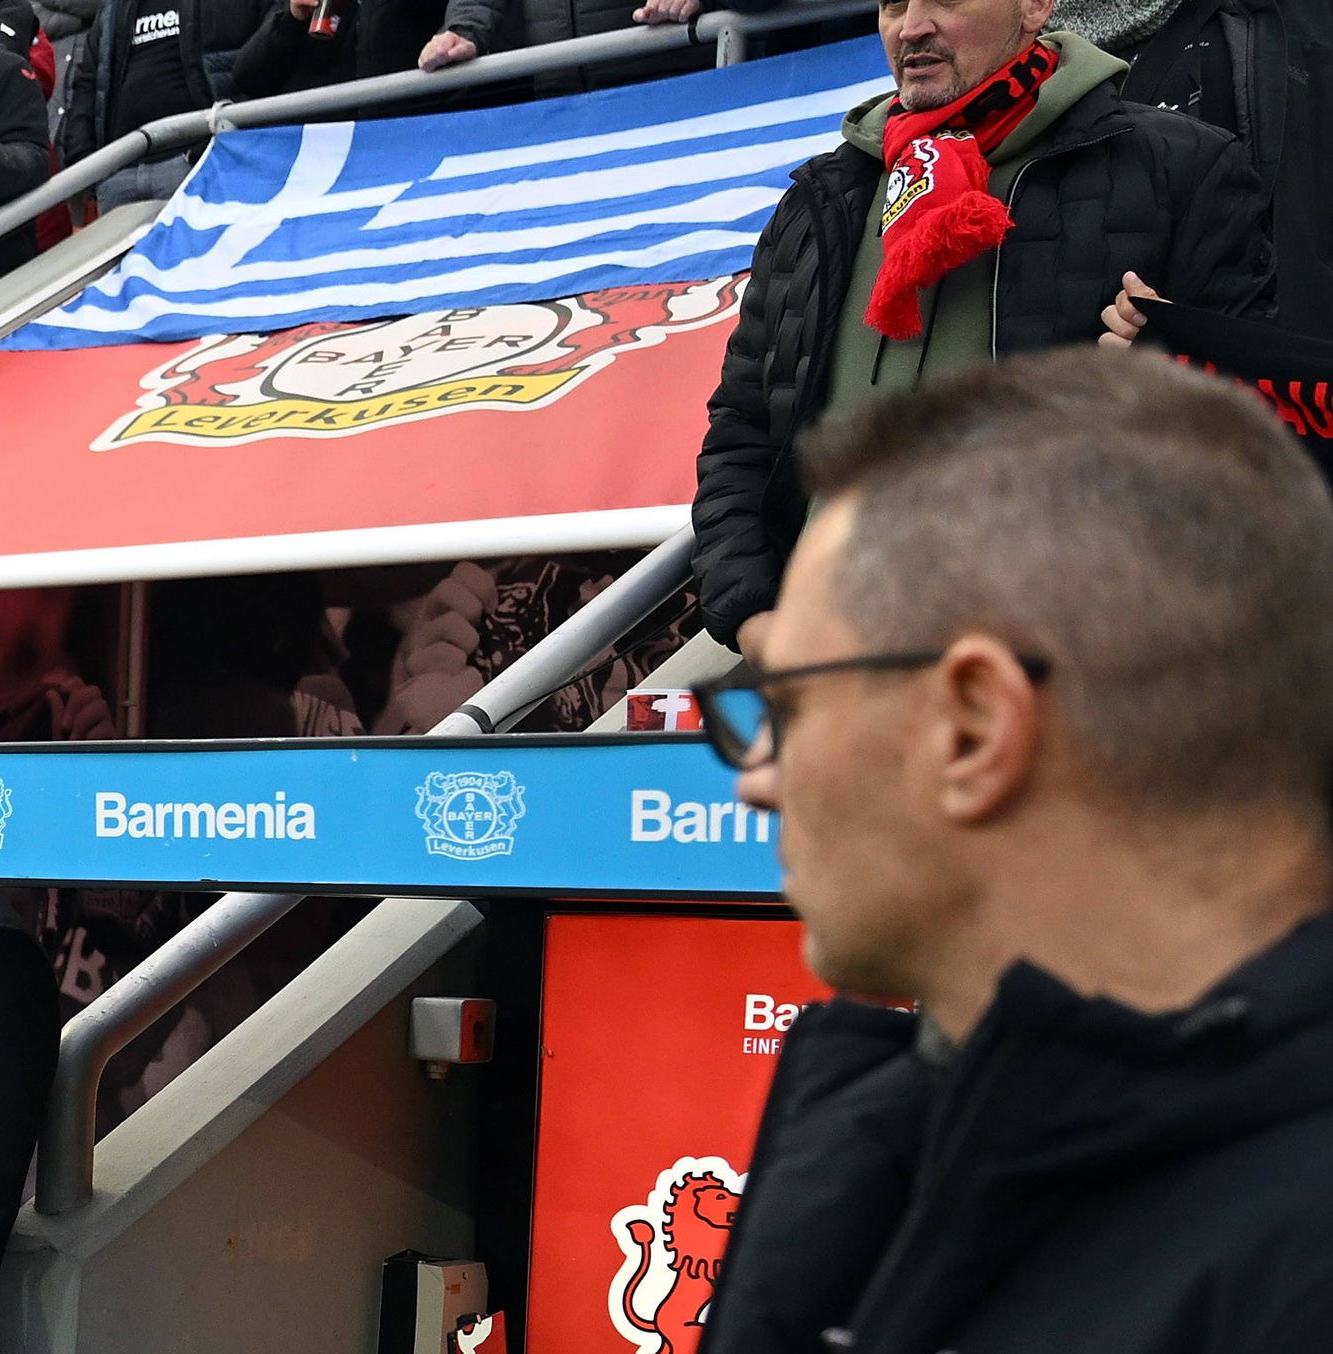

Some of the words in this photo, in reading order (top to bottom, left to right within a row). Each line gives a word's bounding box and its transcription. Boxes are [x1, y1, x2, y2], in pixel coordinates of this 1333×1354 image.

[297, 335, 534, 365] BAYER
[150, 382, 526, 431] Leverkusen
[95, 791, 316, 840] Barmenia
[448, 811, 493, 821] BAYER
[434, 839, 506, 857] Leverkusen
[743, 1037, 781, 1055] EINF
